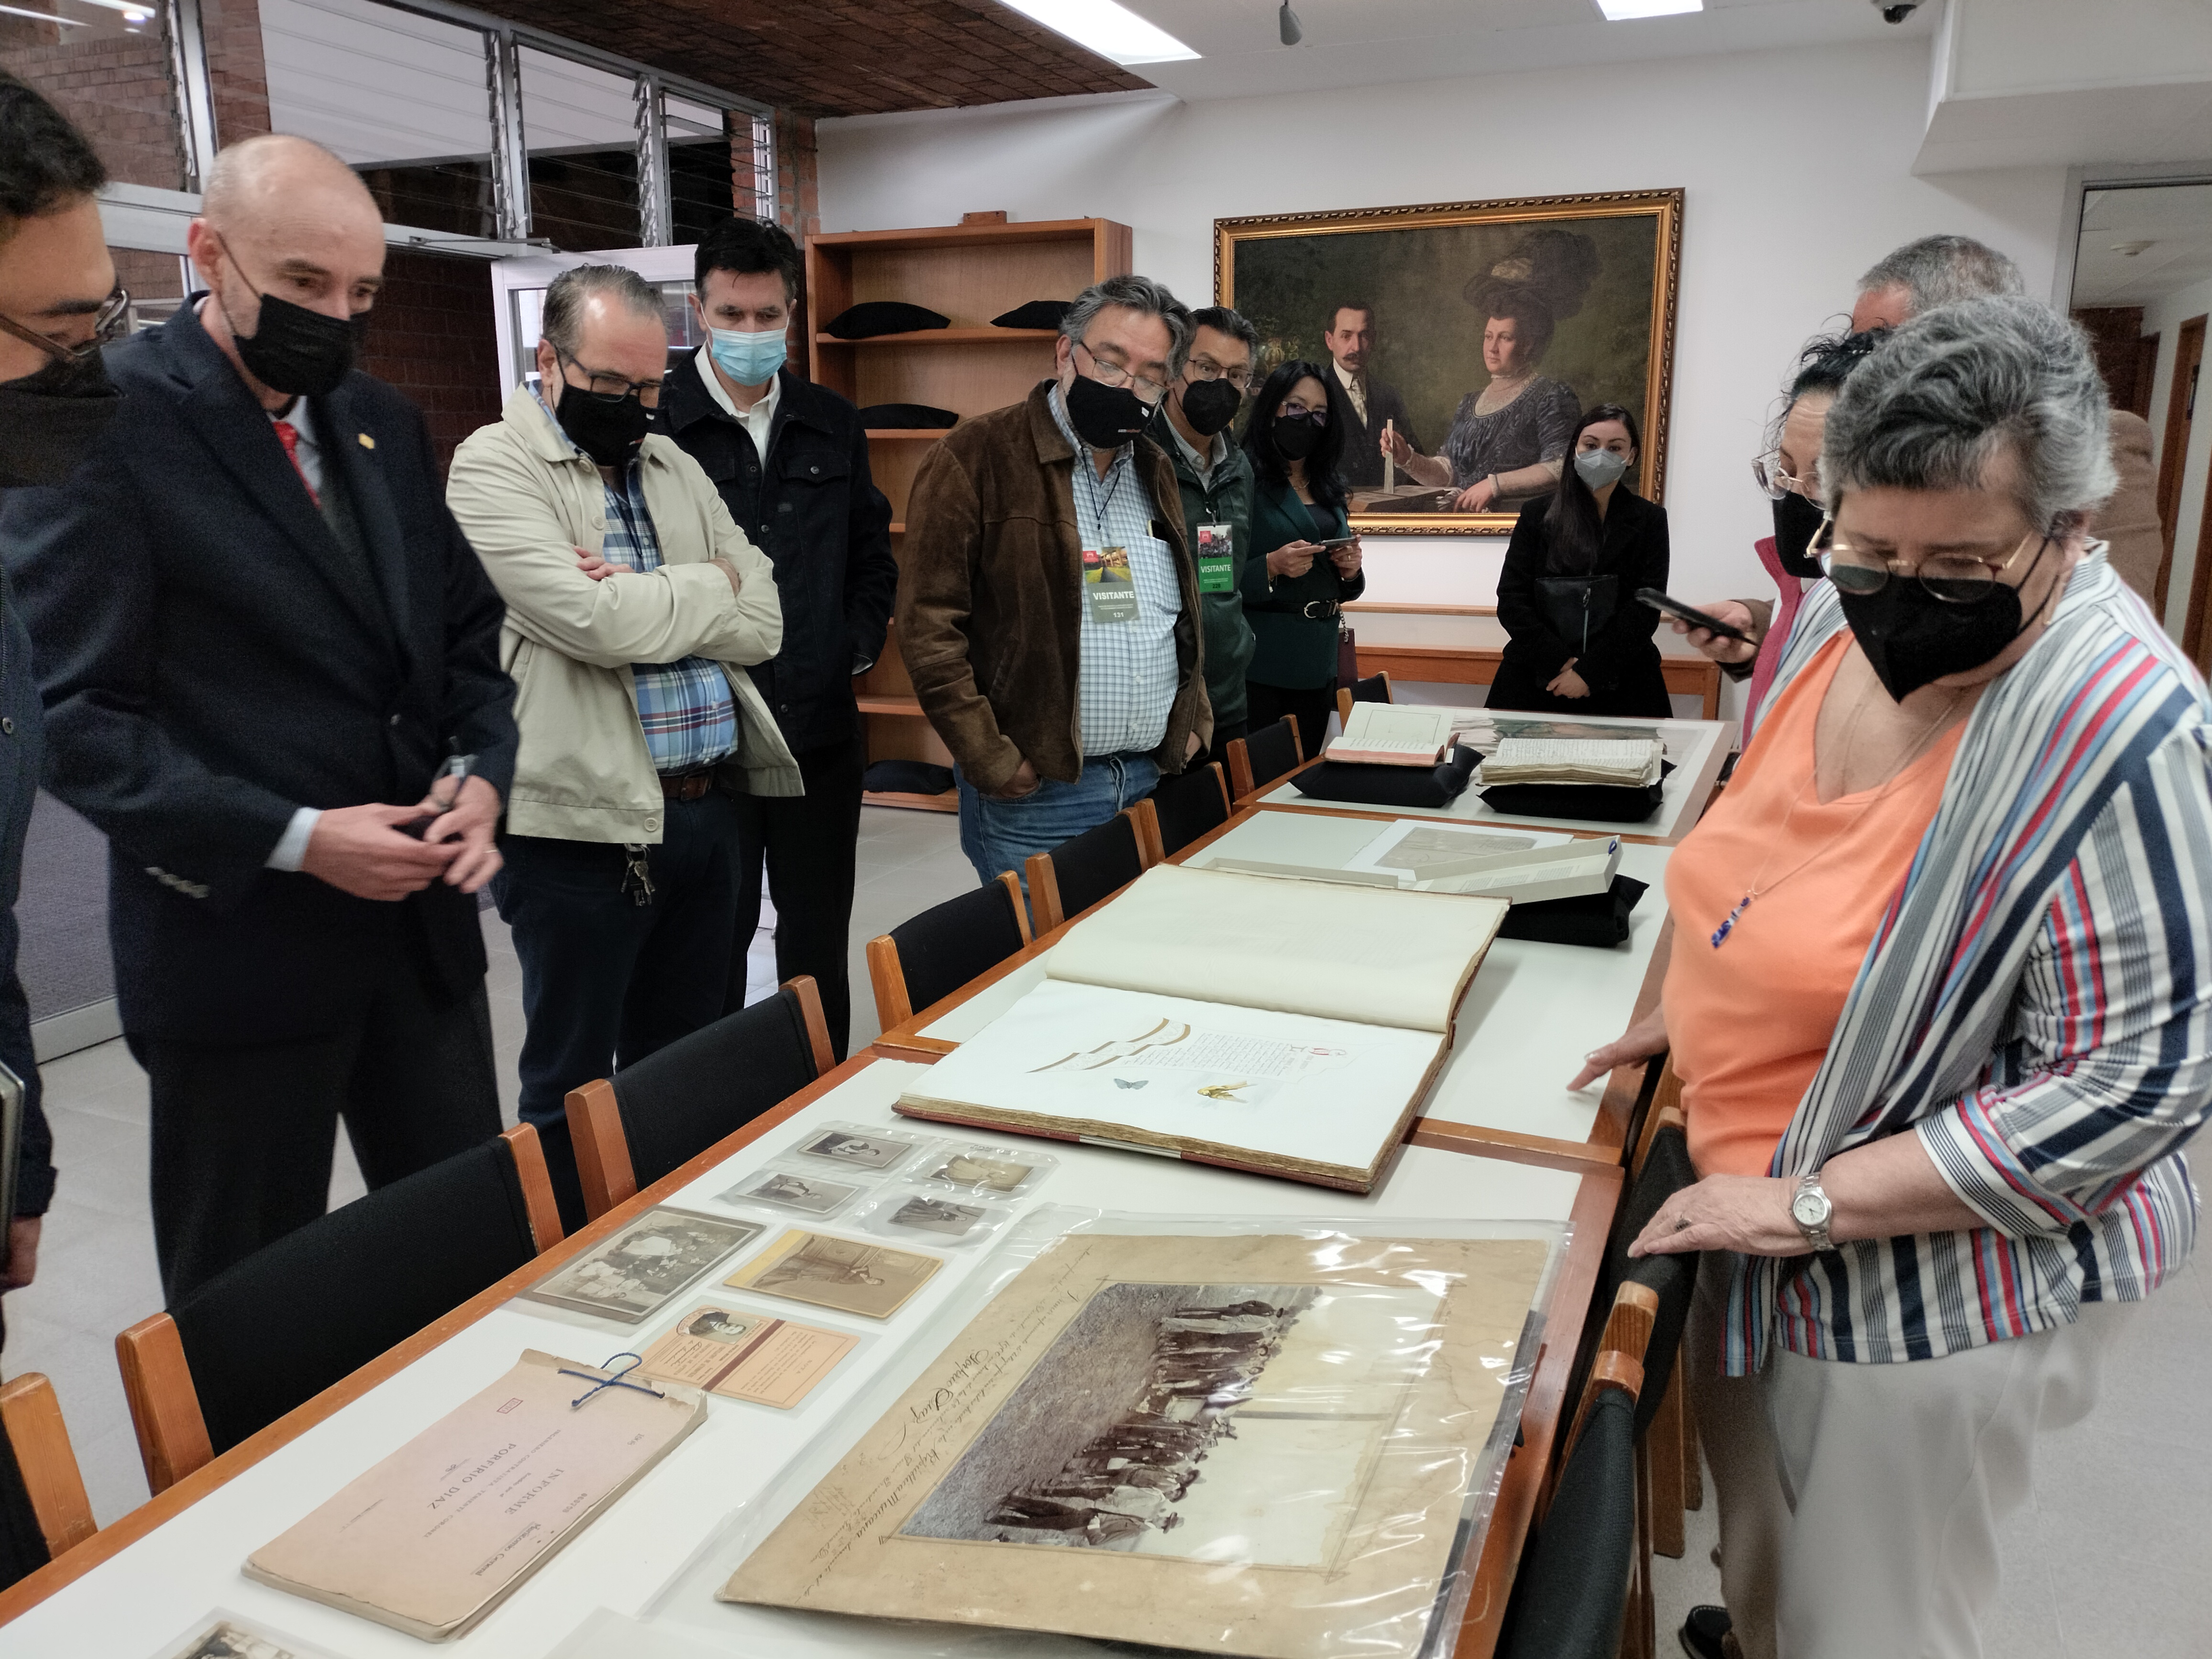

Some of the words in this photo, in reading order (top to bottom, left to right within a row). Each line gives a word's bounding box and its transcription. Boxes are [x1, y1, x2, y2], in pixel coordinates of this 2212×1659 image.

[1201, 564, 1231, 573] VISITANTE
[1093, 591, 1135, 600] VISITANTE
[531, 1429, 561, 1453] INGENIERO
[462, 1443, 516, 1482] PORFIRIO
[427, 1486, 460, 1509] DIAZ
[454, 1490, 486, 1512] TENIENTE
[504, 1468, 564, 1514] INFORME
[422, 1515, 453, 1537] CORONEL
[475, 1553, 504, 1576] General
